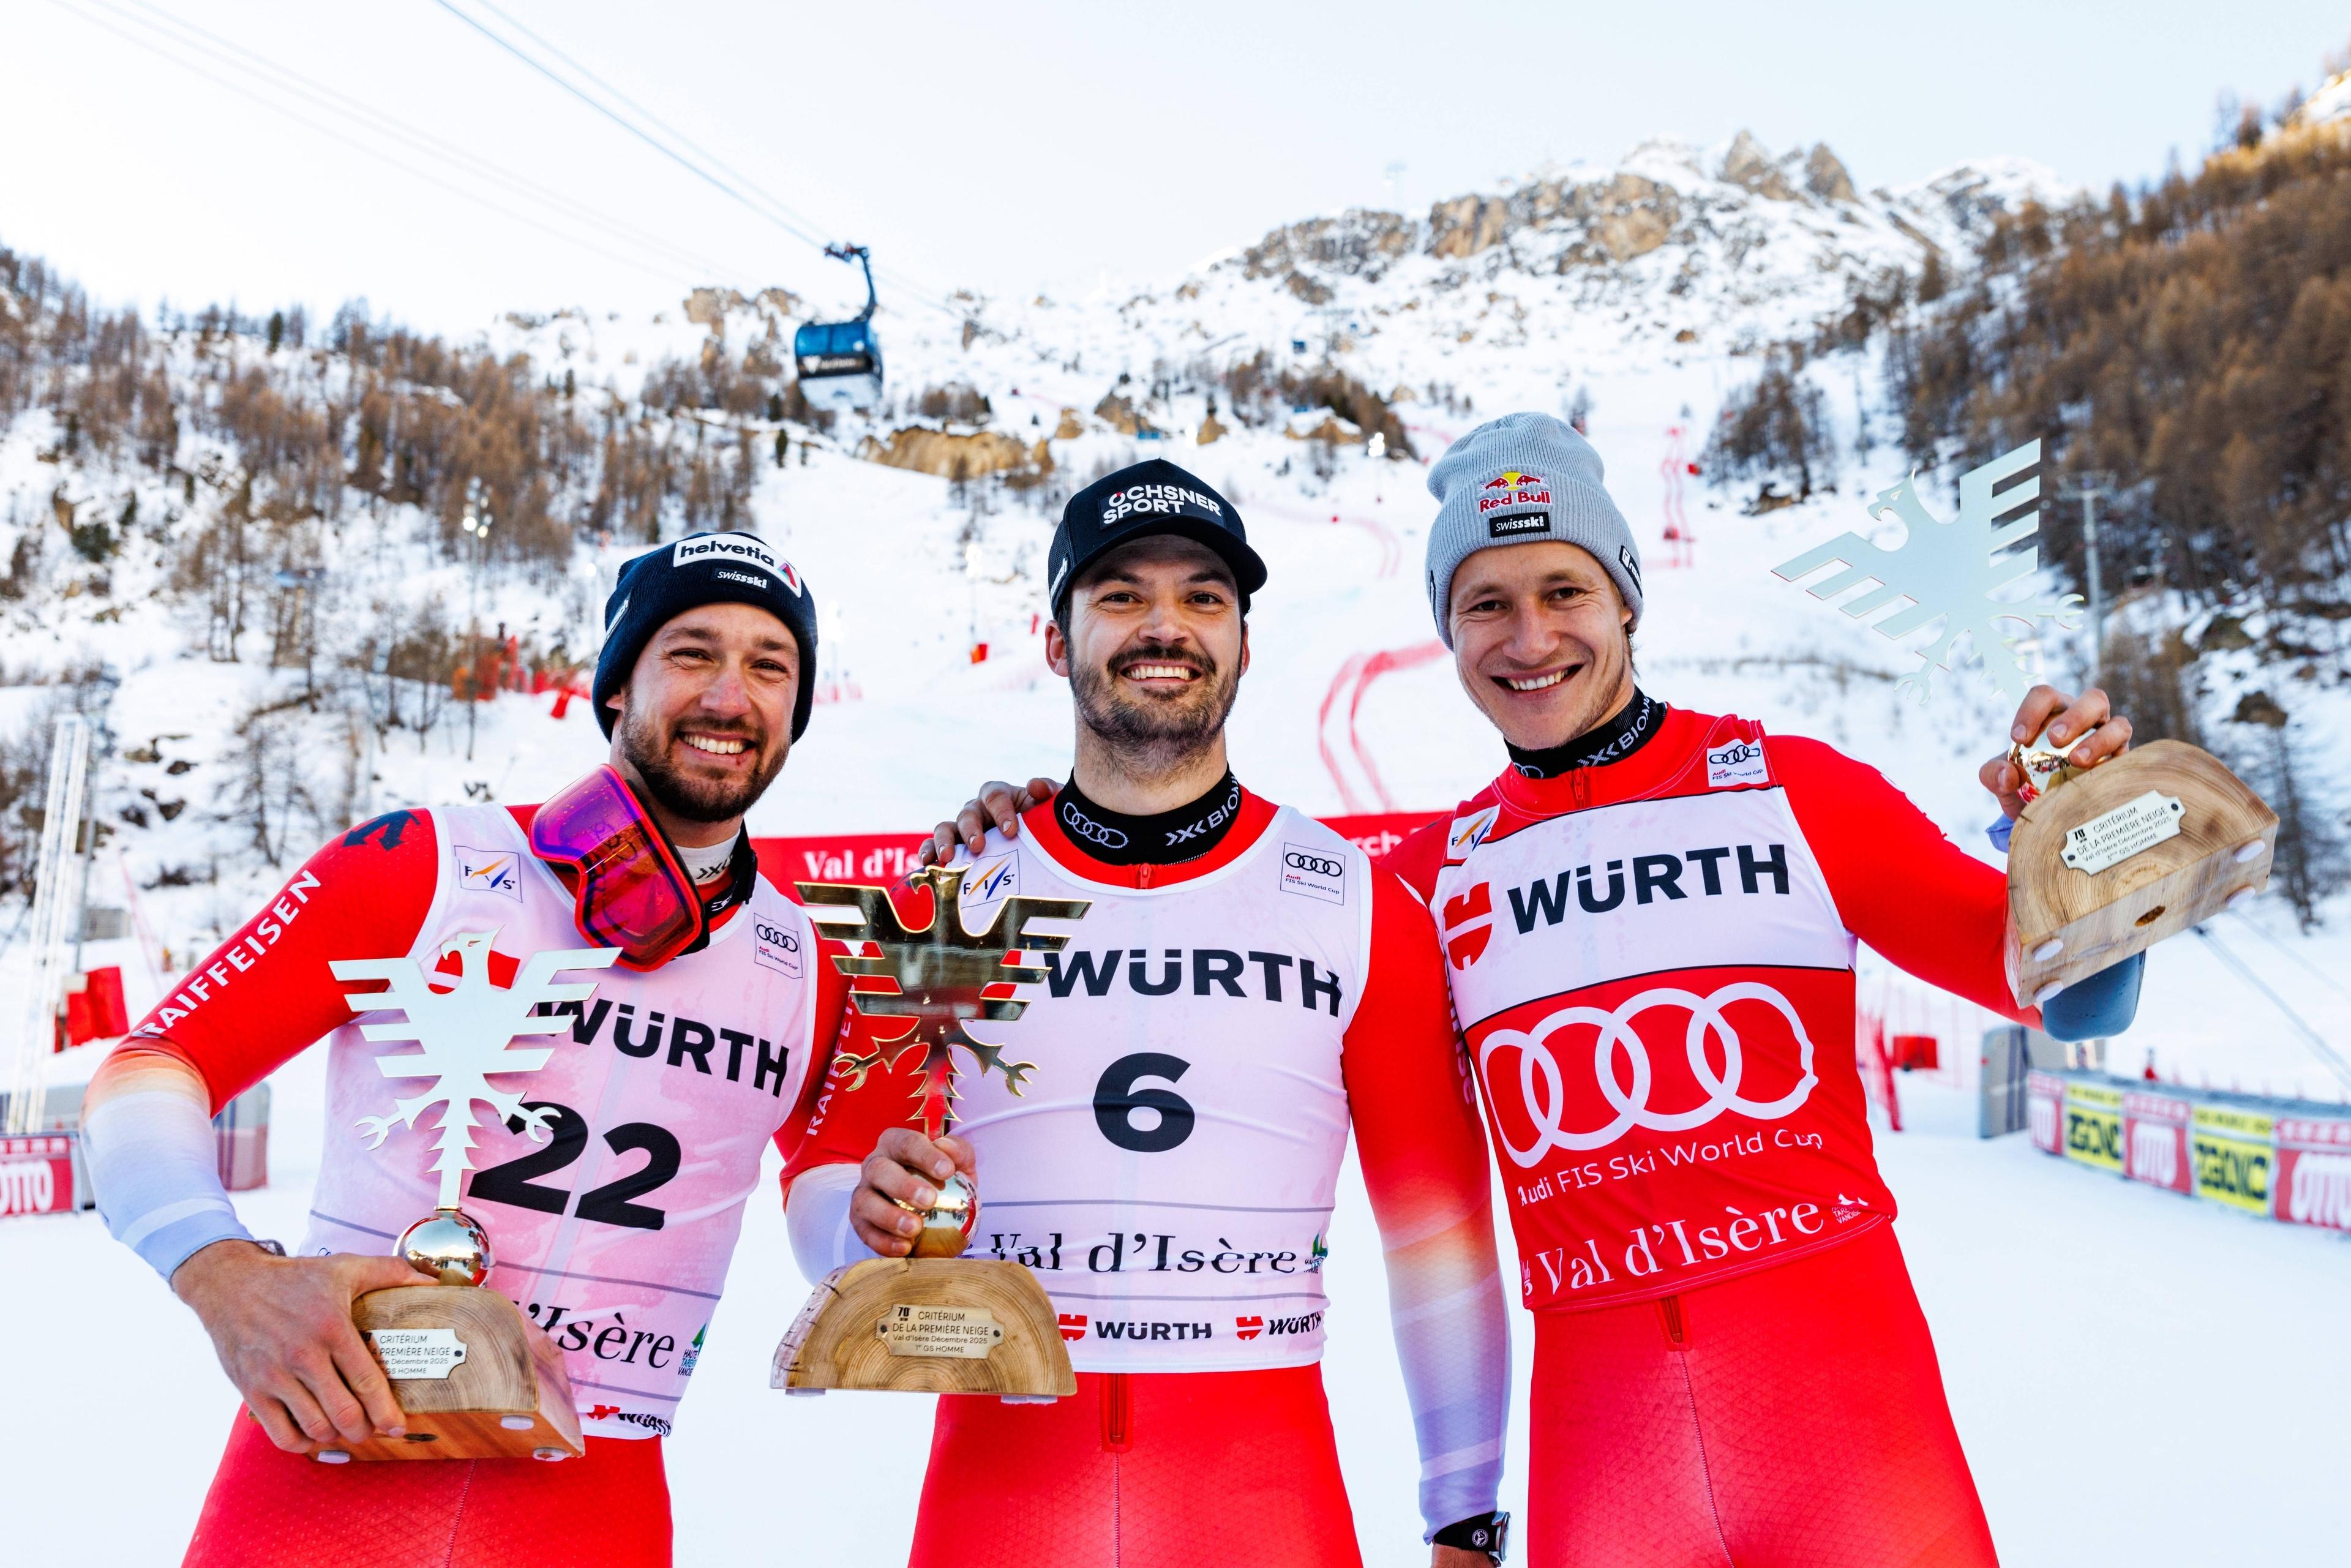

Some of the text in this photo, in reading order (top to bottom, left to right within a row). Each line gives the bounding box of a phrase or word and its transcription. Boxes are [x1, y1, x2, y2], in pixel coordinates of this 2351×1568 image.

[1103, 499, 1185, 524] SPORT
[1109, 484, 1221, 517] OCHSNER
[1480, 490, 1551, 512] Red Bull
[1496, 516, 1544, 531] swissski
[680, 541, 774, 567] helvetia
[718, 571, 767, 588] swissski
[2077, 844, 2090, 855] DE
[2089, 838, 2101, 849] LA
[2142, 806, 2168, 822] NEIGE
[2093, 807, 2139, 833] CRITÉRIUM
[2083, 853, 2094, 862] Val
[2154, 816, 2172, 828] 2025
[2120, 847, 2131, 855] GS
[2131, 833, 2159, 849] HOMME
[803, 849, 855, 880] Val
[1507, 844, 1790, 935] WÜRTH
[131, 869, 322, 1040] RAIFFEISEN
[1044, 949, 1342, 1017] WÜRTH
[1093, 1052, 1195, 1153] 6
[467, 1101, 681, 1231] 22
[1556, 1163, 1602, 1193] FIS
[1608, 1149, 1656, 1181] Ski
[1660, 1130, 1763, 1167] World
[1774, 1129, 1823, 1150] Cup
[990, 1233, 1062, 1270] Val
[1089, 1233, 1296, 1274] d'Isère
[1536, 1202, 1824, 1295] Val d'Isère
[918, 1310, 965, 1321] CRITÉRIUM
[1269, 1311, 1321, 1335] WÜRTH
[380, 1334, 427, 1344] CRITÉRIUM
[893, 1323, 989, 1335] DE LA PREMIÈRE NEIGE
[1095, 1321, 1212, 1340] WÜRTH
[380, 1346, 423, 1356] PREMIÈRE
[424, 1347, 451, 1356] NEIGE
